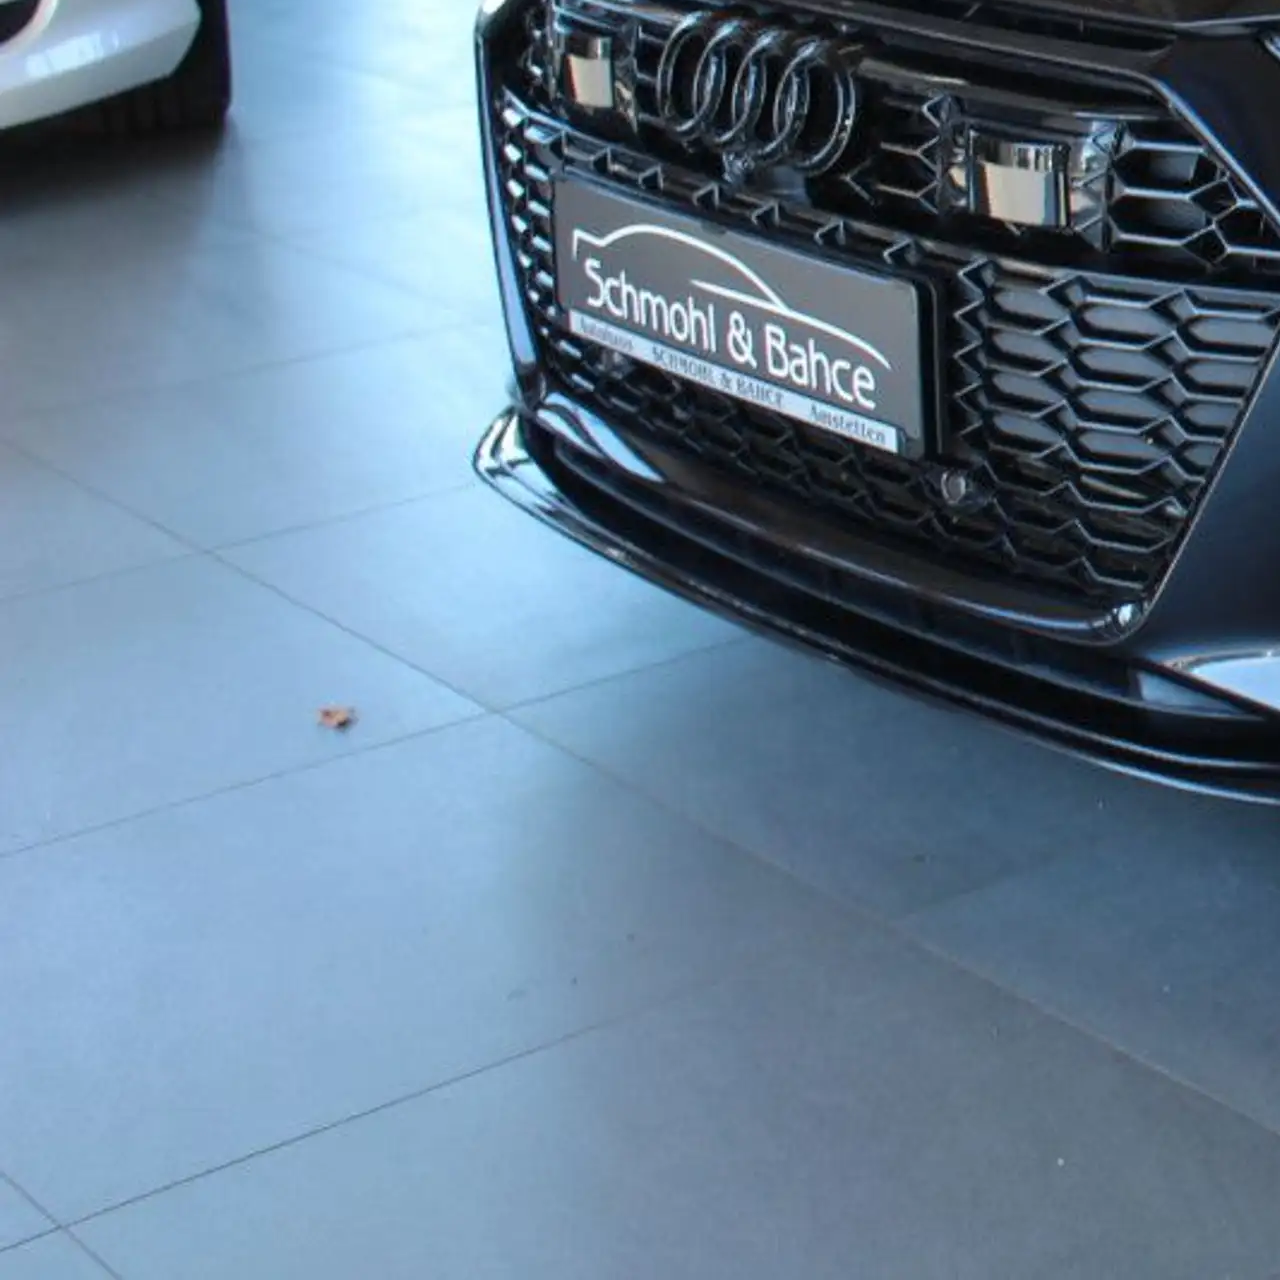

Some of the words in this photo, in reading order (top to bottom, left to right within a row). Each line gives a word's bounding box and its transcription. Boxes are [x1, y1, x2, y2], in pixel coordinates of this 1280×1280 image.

[584, 258, 717, 353] Schmohl
[727, 310, 758, 369] &
[764, 323, 877, 411] Bahce
[720, 373, 733, 392] &
